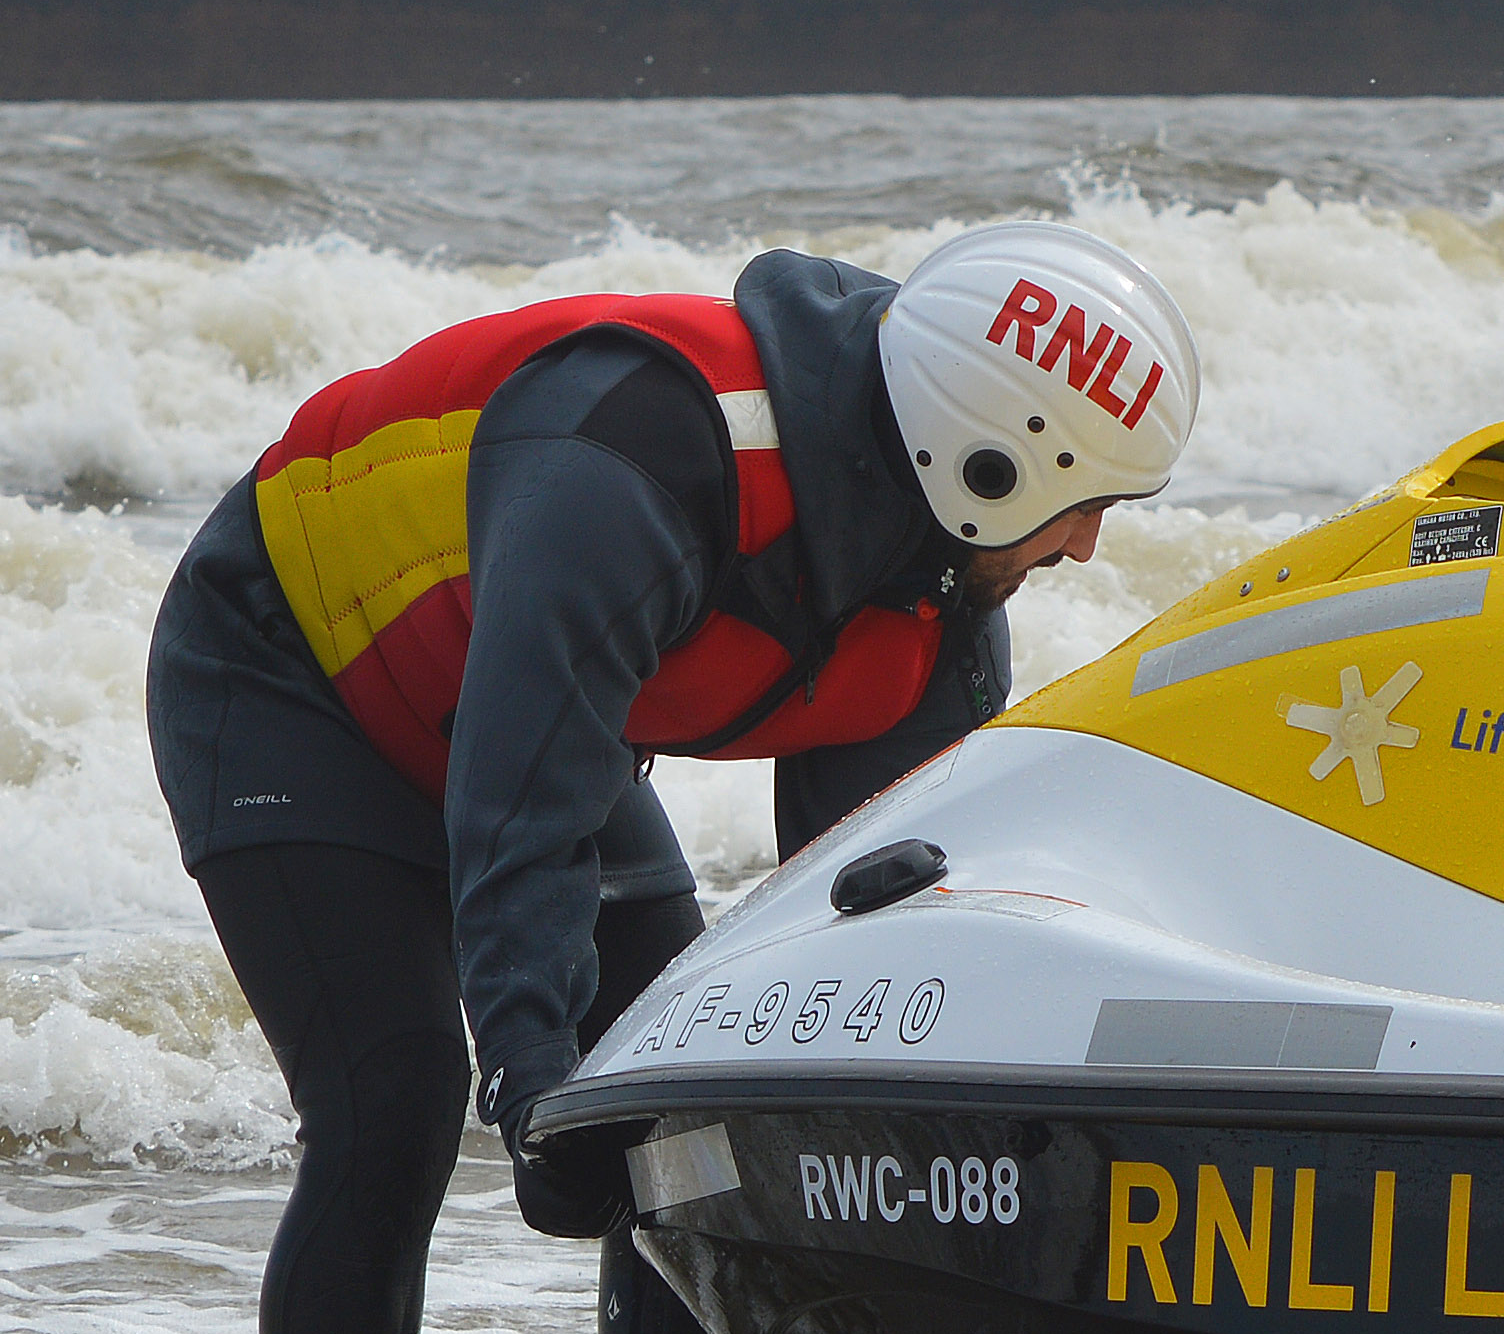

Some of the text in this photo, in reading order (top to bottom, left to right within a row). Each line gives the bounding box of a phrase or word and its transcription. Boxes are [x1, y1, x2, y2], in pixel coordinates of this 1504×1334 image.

[985, 277, 1165, 431] RNLI
[632, 977, 946, 1056] AF-9540
[799, 1154, 1020, 1225] RWC-088
[1106, 1161, 1397, 1314] RNLI
